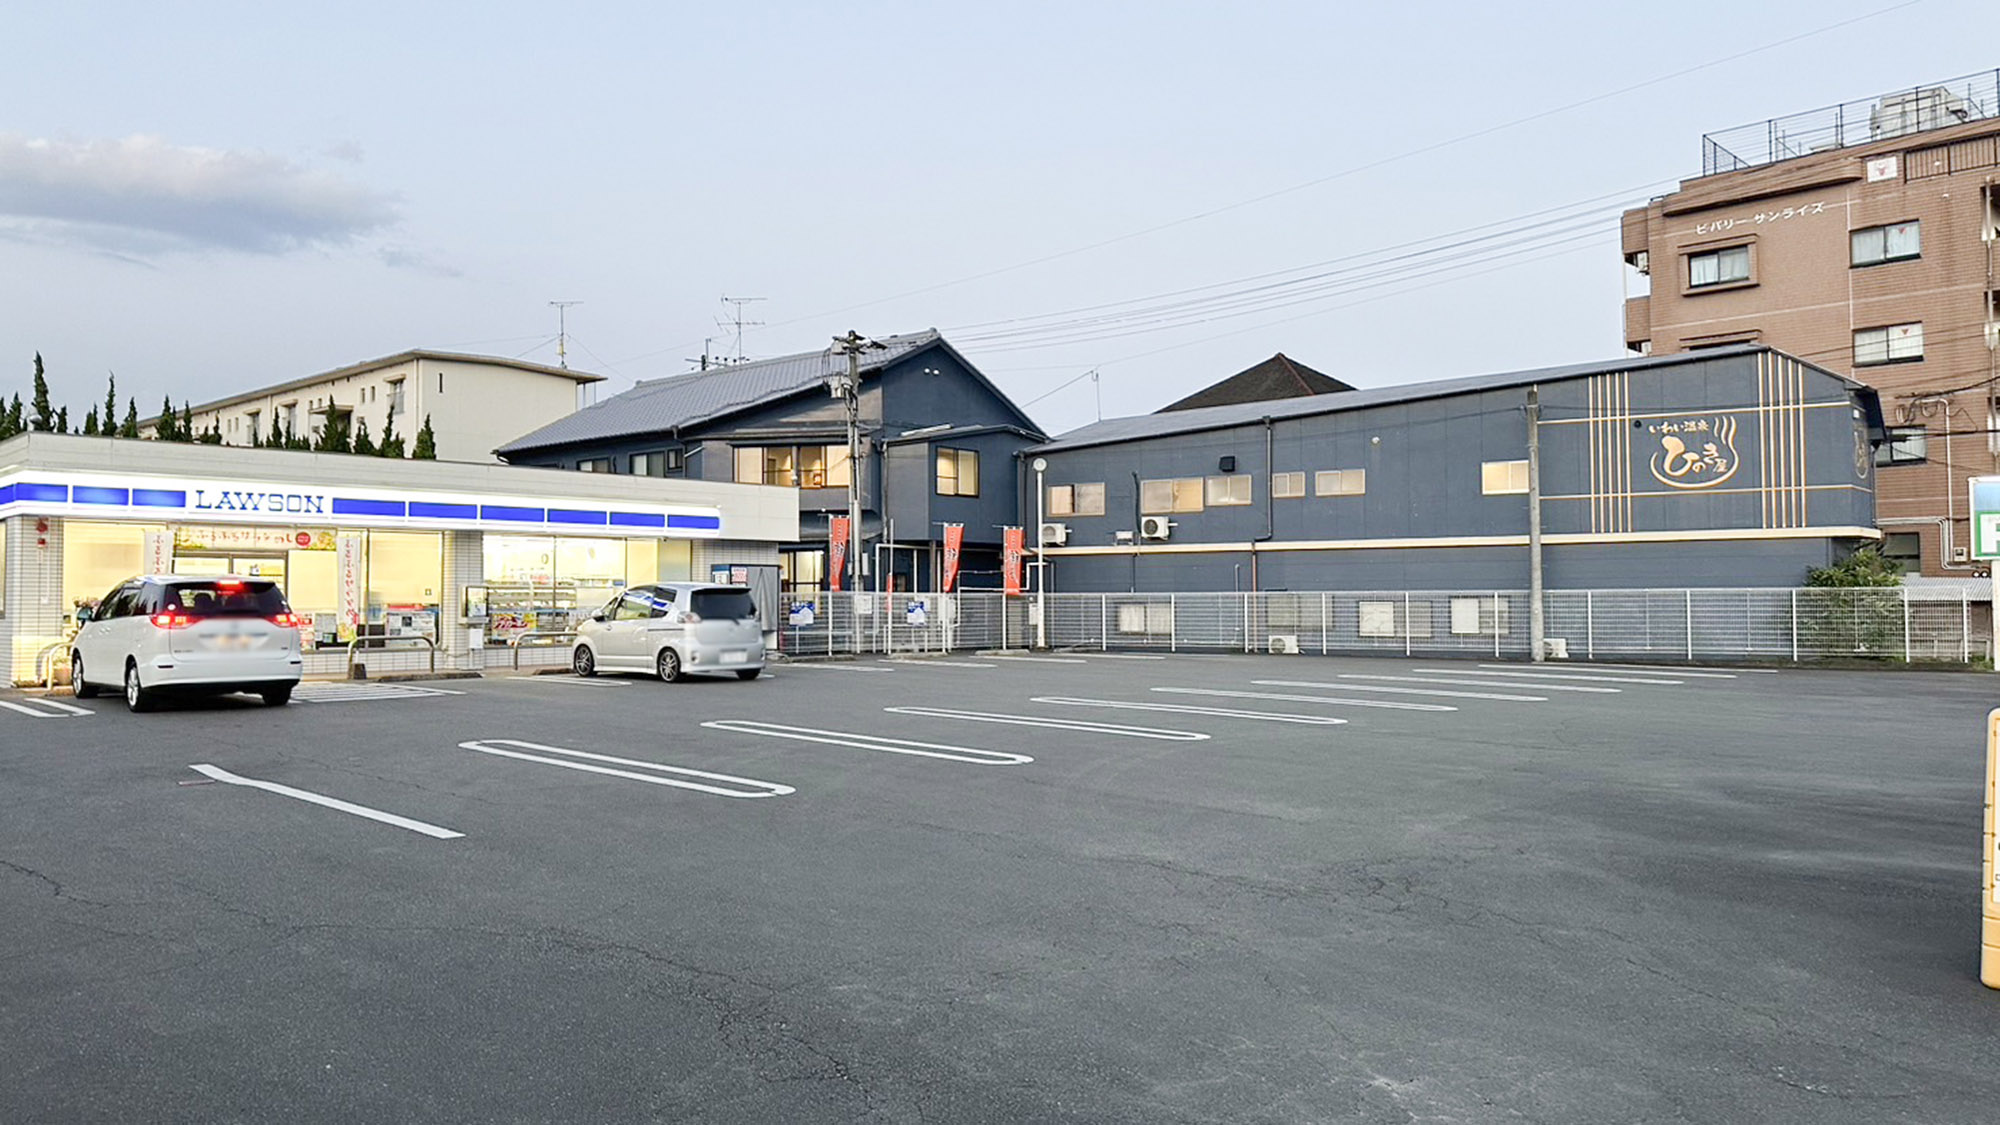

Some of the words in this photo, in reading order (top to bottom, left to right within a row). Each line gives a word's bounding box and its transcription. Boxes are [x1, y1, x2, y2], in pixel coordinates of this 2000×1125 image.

[1753, 201, 1825, 224] サンライズ
[1649, 419, 1709, 434] いわい温泉
[195, 489, 324, 514] LAWSON
